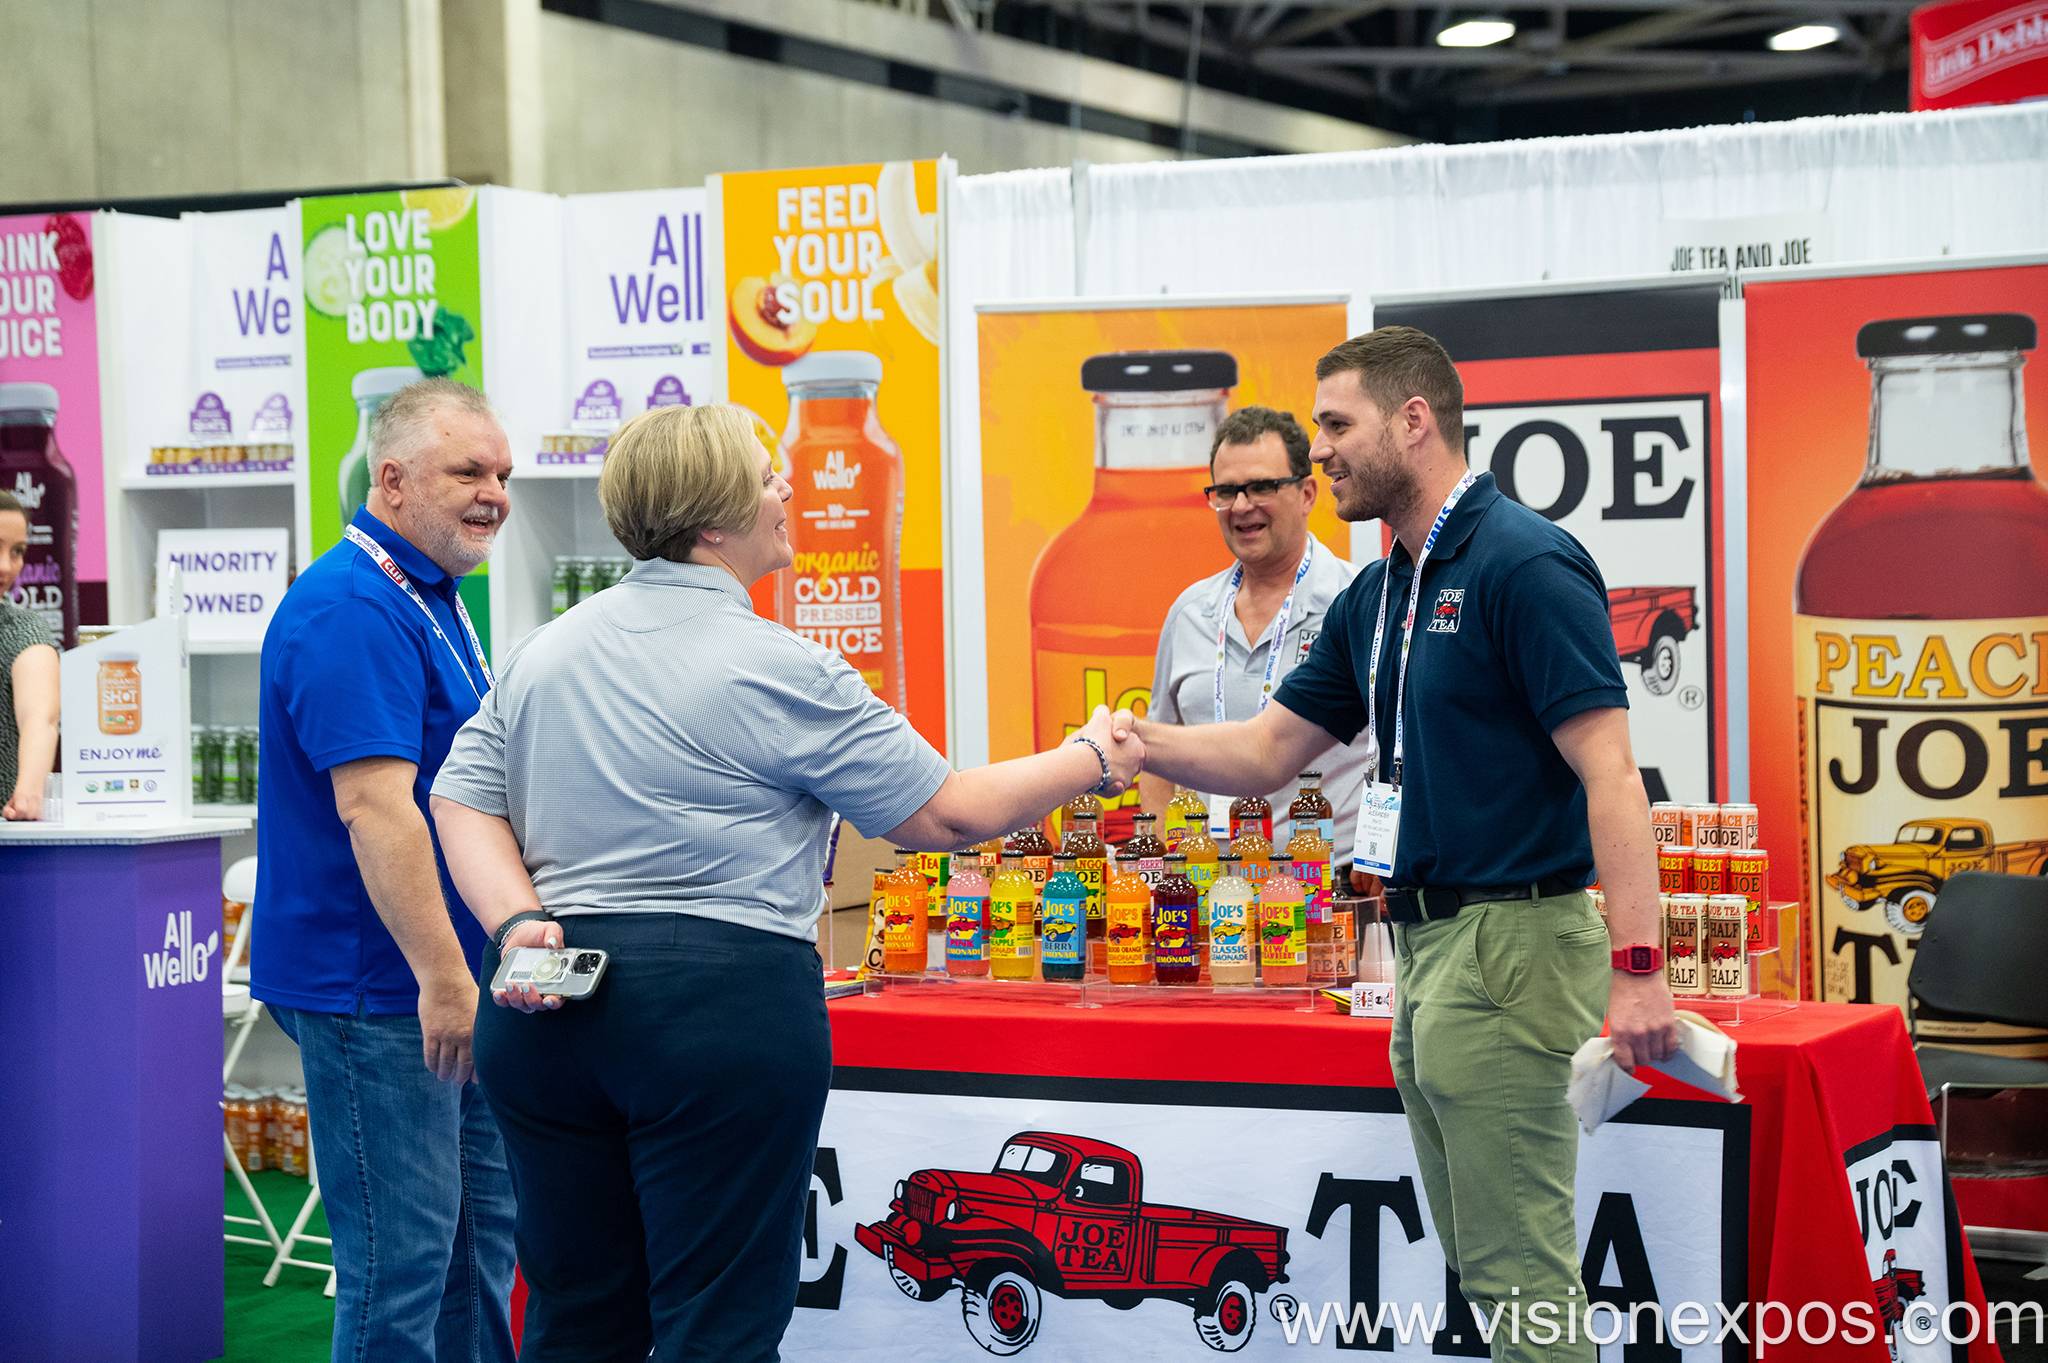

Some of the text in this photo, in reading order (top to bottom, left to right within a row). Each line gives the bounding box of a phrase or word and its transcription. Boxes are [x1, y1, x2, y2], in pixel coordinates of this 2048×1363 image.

[777, 184, 876, 231] FEED
[346, 209, 433, 252] LOVE
[650, 213, 703, 266] All
[773, 231, 881, 276] YOUR
[1672, 237, 1812, 272] JOE TEA AND JOE
[345, 254, 436, 299] YOUR
[775, 279, 885, 324] SOUL
[346, 299, 438, 344] BODY
[826, 451, 845, 472] All
[1425, 506, 1451, 551] HALLS
[170, 552, 279, 571] MINORITY
[793, 542, 880, 591] organic
[383, 561, 404, 584] CLIF
[794, 575, 881, 603] COLD
[1438, 591, 1463, 603] JOE
[800, 606, 878, 623] PRESSED
[1432, 619, 1456, 631] TEA
[104, 689, 137, 703] SHOT
[79, 748, 133, 761] ENJOY
[1730, 860, 1763, 873] SWEET
[1733, 876, 1760, 892] JOE
[885, 892, 911, 910] JOE'S
[948, 898, 979, 915] JOE'S
[1044, 899, 1076, 918] JOE'S
[1680, 904, 1698, 915] TEA
[1108, 904, 1138, 921] JOE'S
[1156, 907, 1188, 924] JOE'S
[1211, 902, 1244, 920] JOE'S
[1260, 903, 1290, 920] JOE'S
[1724, 906, 1740, 917] TEA
[164, 911, 193, 950] All
[1710, 922, 1741, 938] HALF
[949, 939, 975, 948] PINK
[1044, 942, 1073, 951] BERRY
[1211, 945, 1248, 954] CLASSIC
[1263, 944, 1289, 953] KIWI
[144, 943, 210, 989] Wello
[1312, 959, 1348, 973] TEA
[1711, 968, 1741, 985] HALF
[1060, 1221, 1125, 1249] JOE
[1057, 1242, 1123, 1271] TEA
[1305, 1171, 1683, 1363] TA
